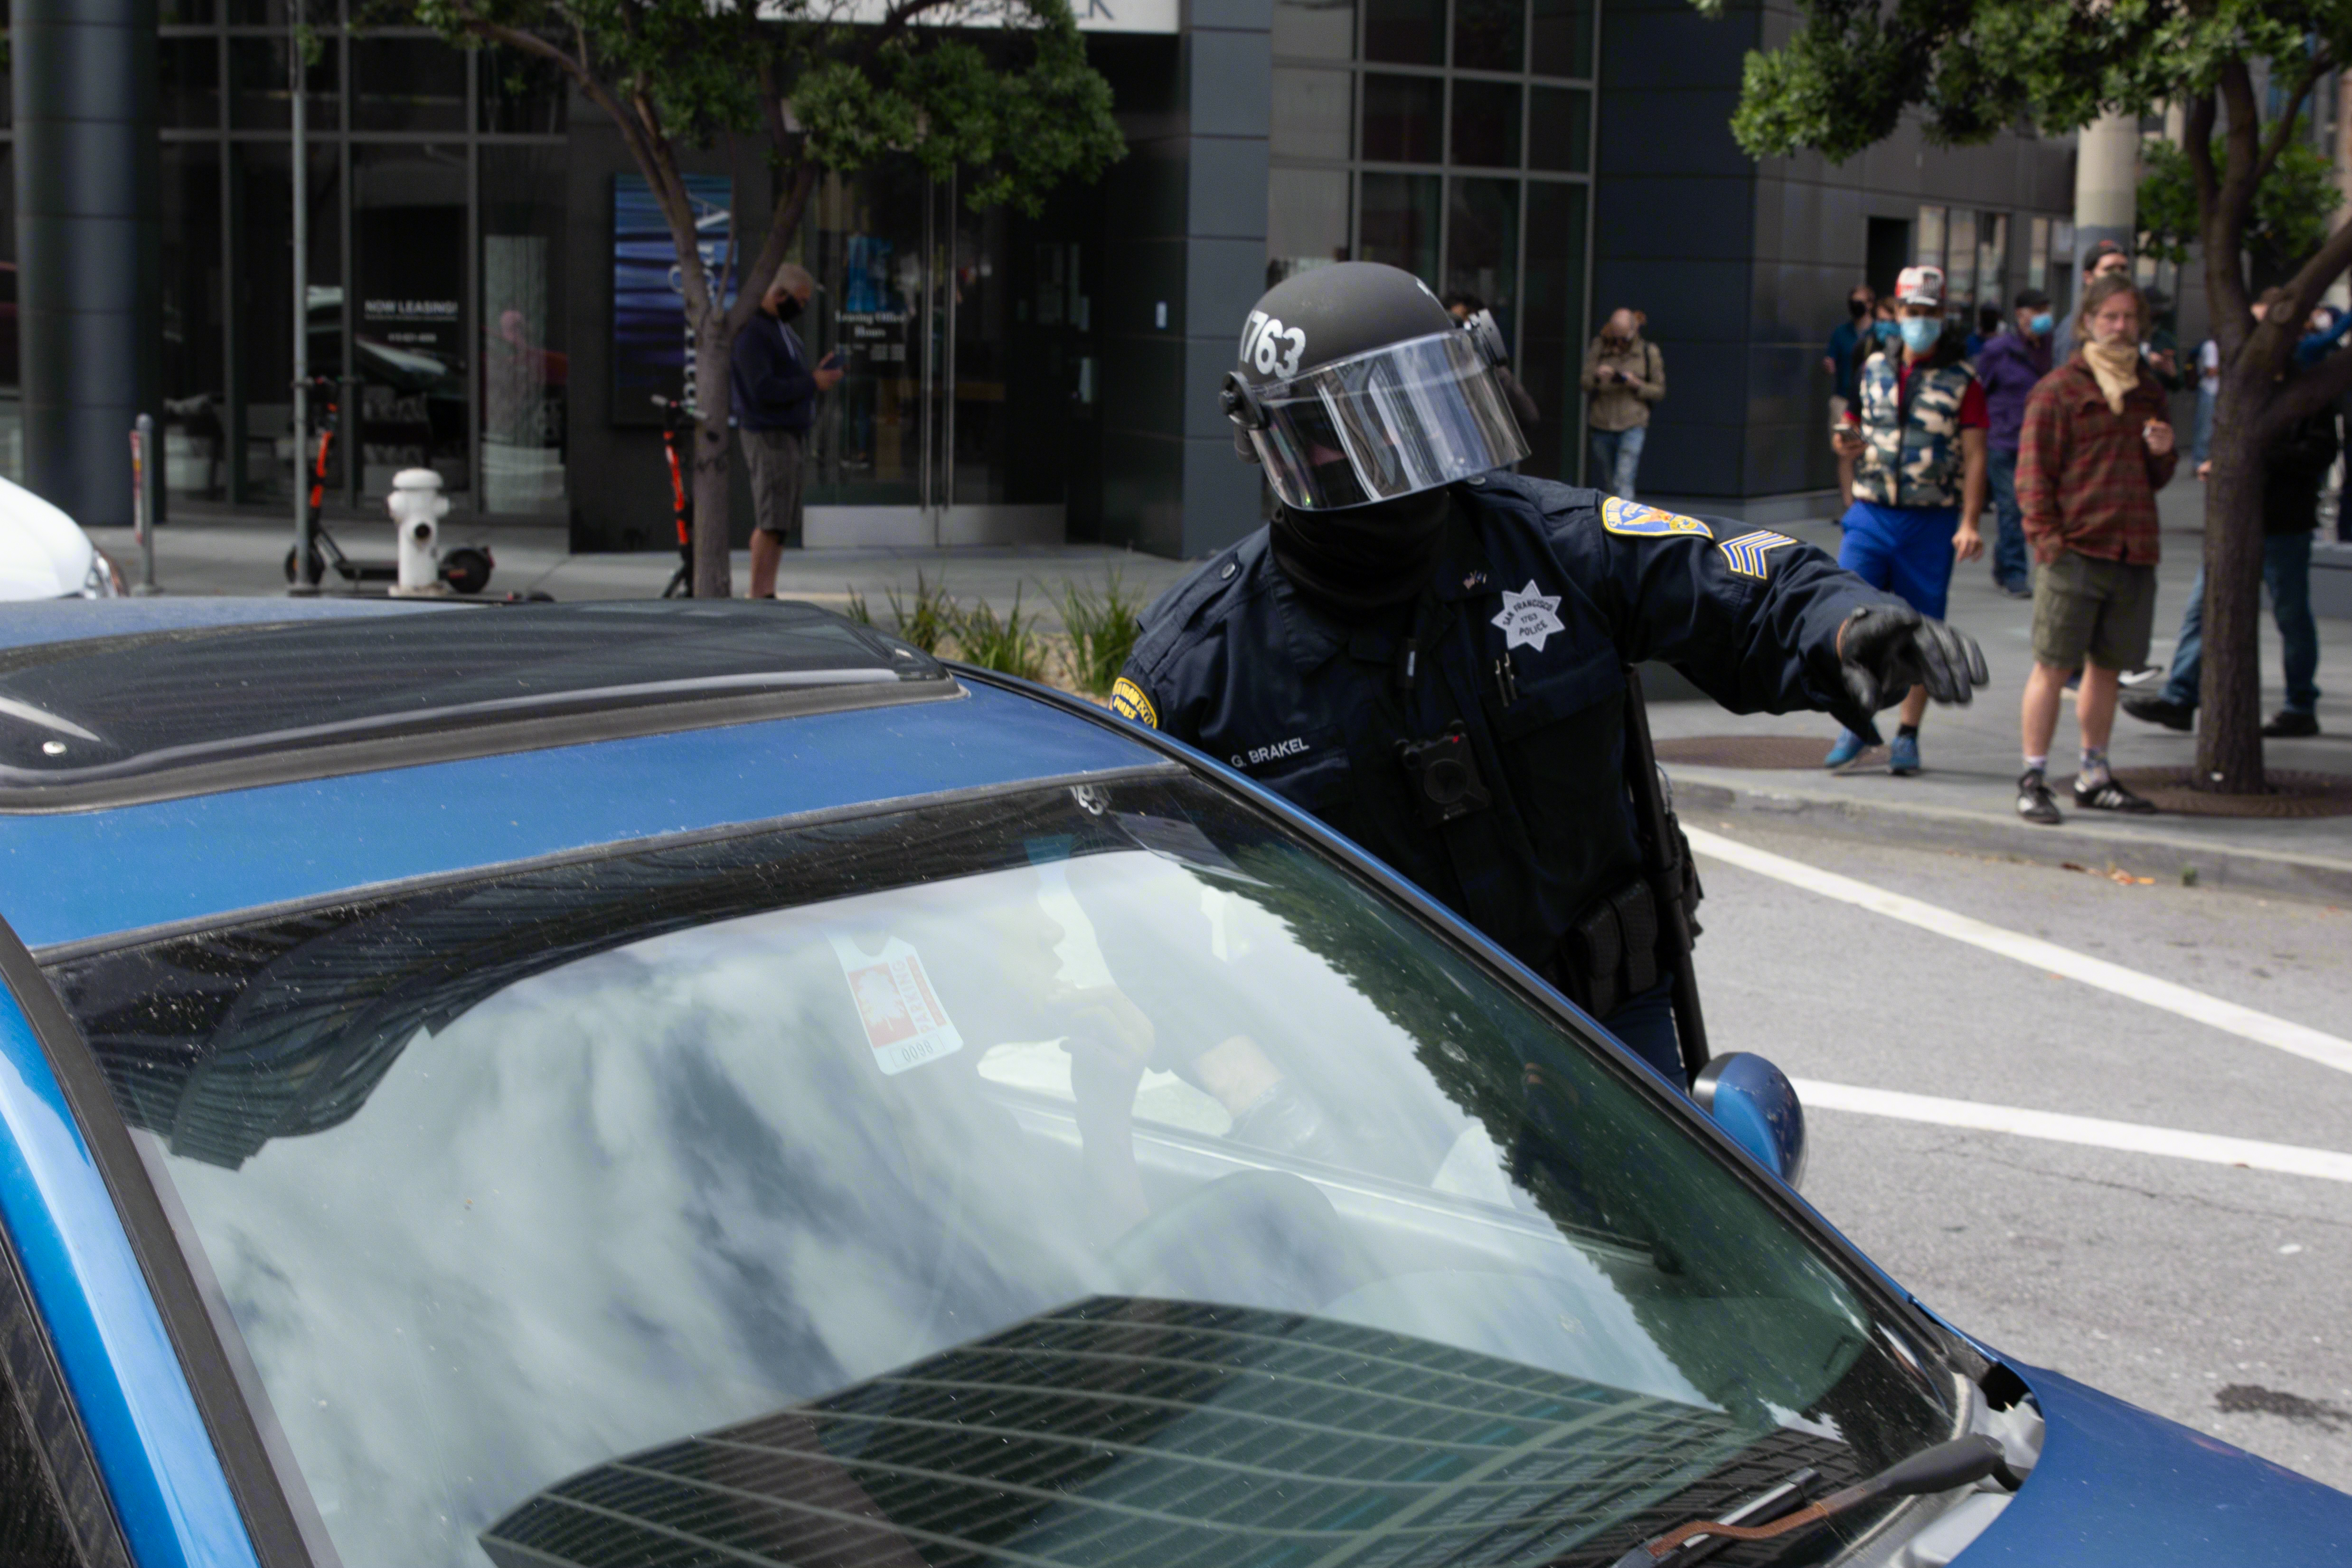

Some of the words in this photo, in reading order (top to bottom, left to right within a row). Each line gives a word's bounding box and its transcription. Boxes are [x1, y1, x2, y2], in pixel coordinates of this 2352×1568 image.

[1502, 611, 1515, 626] SAN
[1514, 599, 1552, 612] FRANCISCO
[1521, 613, 1538, 624] 1763
[1519, 620, 1548, 637] POLICE
[1248, 737, 1310, 764] BRAKEL
[892, 959, 935, 1034] PARKING
